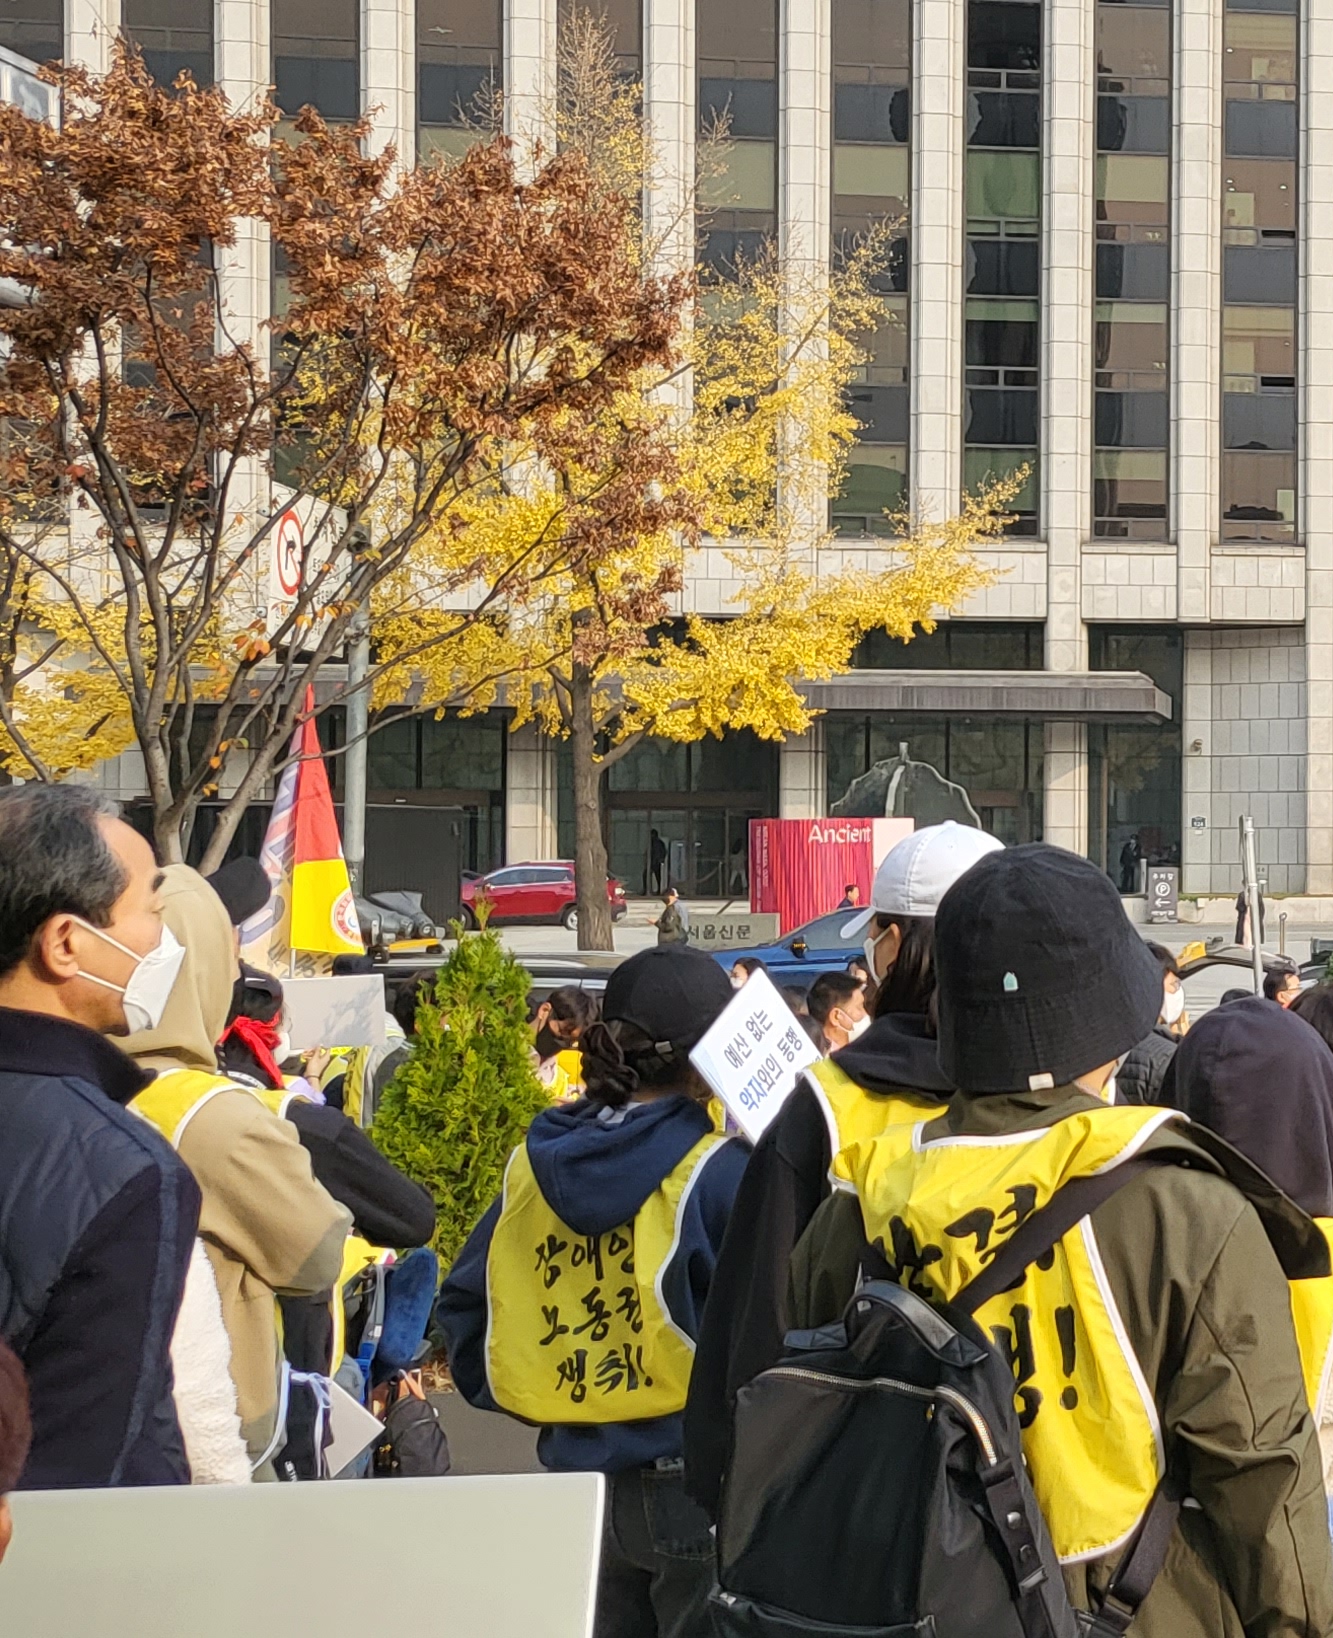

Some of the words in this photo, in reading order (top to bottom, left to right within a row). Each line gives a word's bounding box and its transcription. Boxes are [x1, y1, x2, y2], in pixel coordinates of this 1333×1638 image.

[808, 824, 872, 844] Ancient
[687, 924, 751, 940] 서울신문
[723, 1032, 753, 1069] 예산
[745, 1009, 774, 1043] 없는
[738, 1052, 785, 1112] 약자와의
[776, 1025, 803, 1063] 동행
[555, 1342, 654, 1404] 쟁취!
